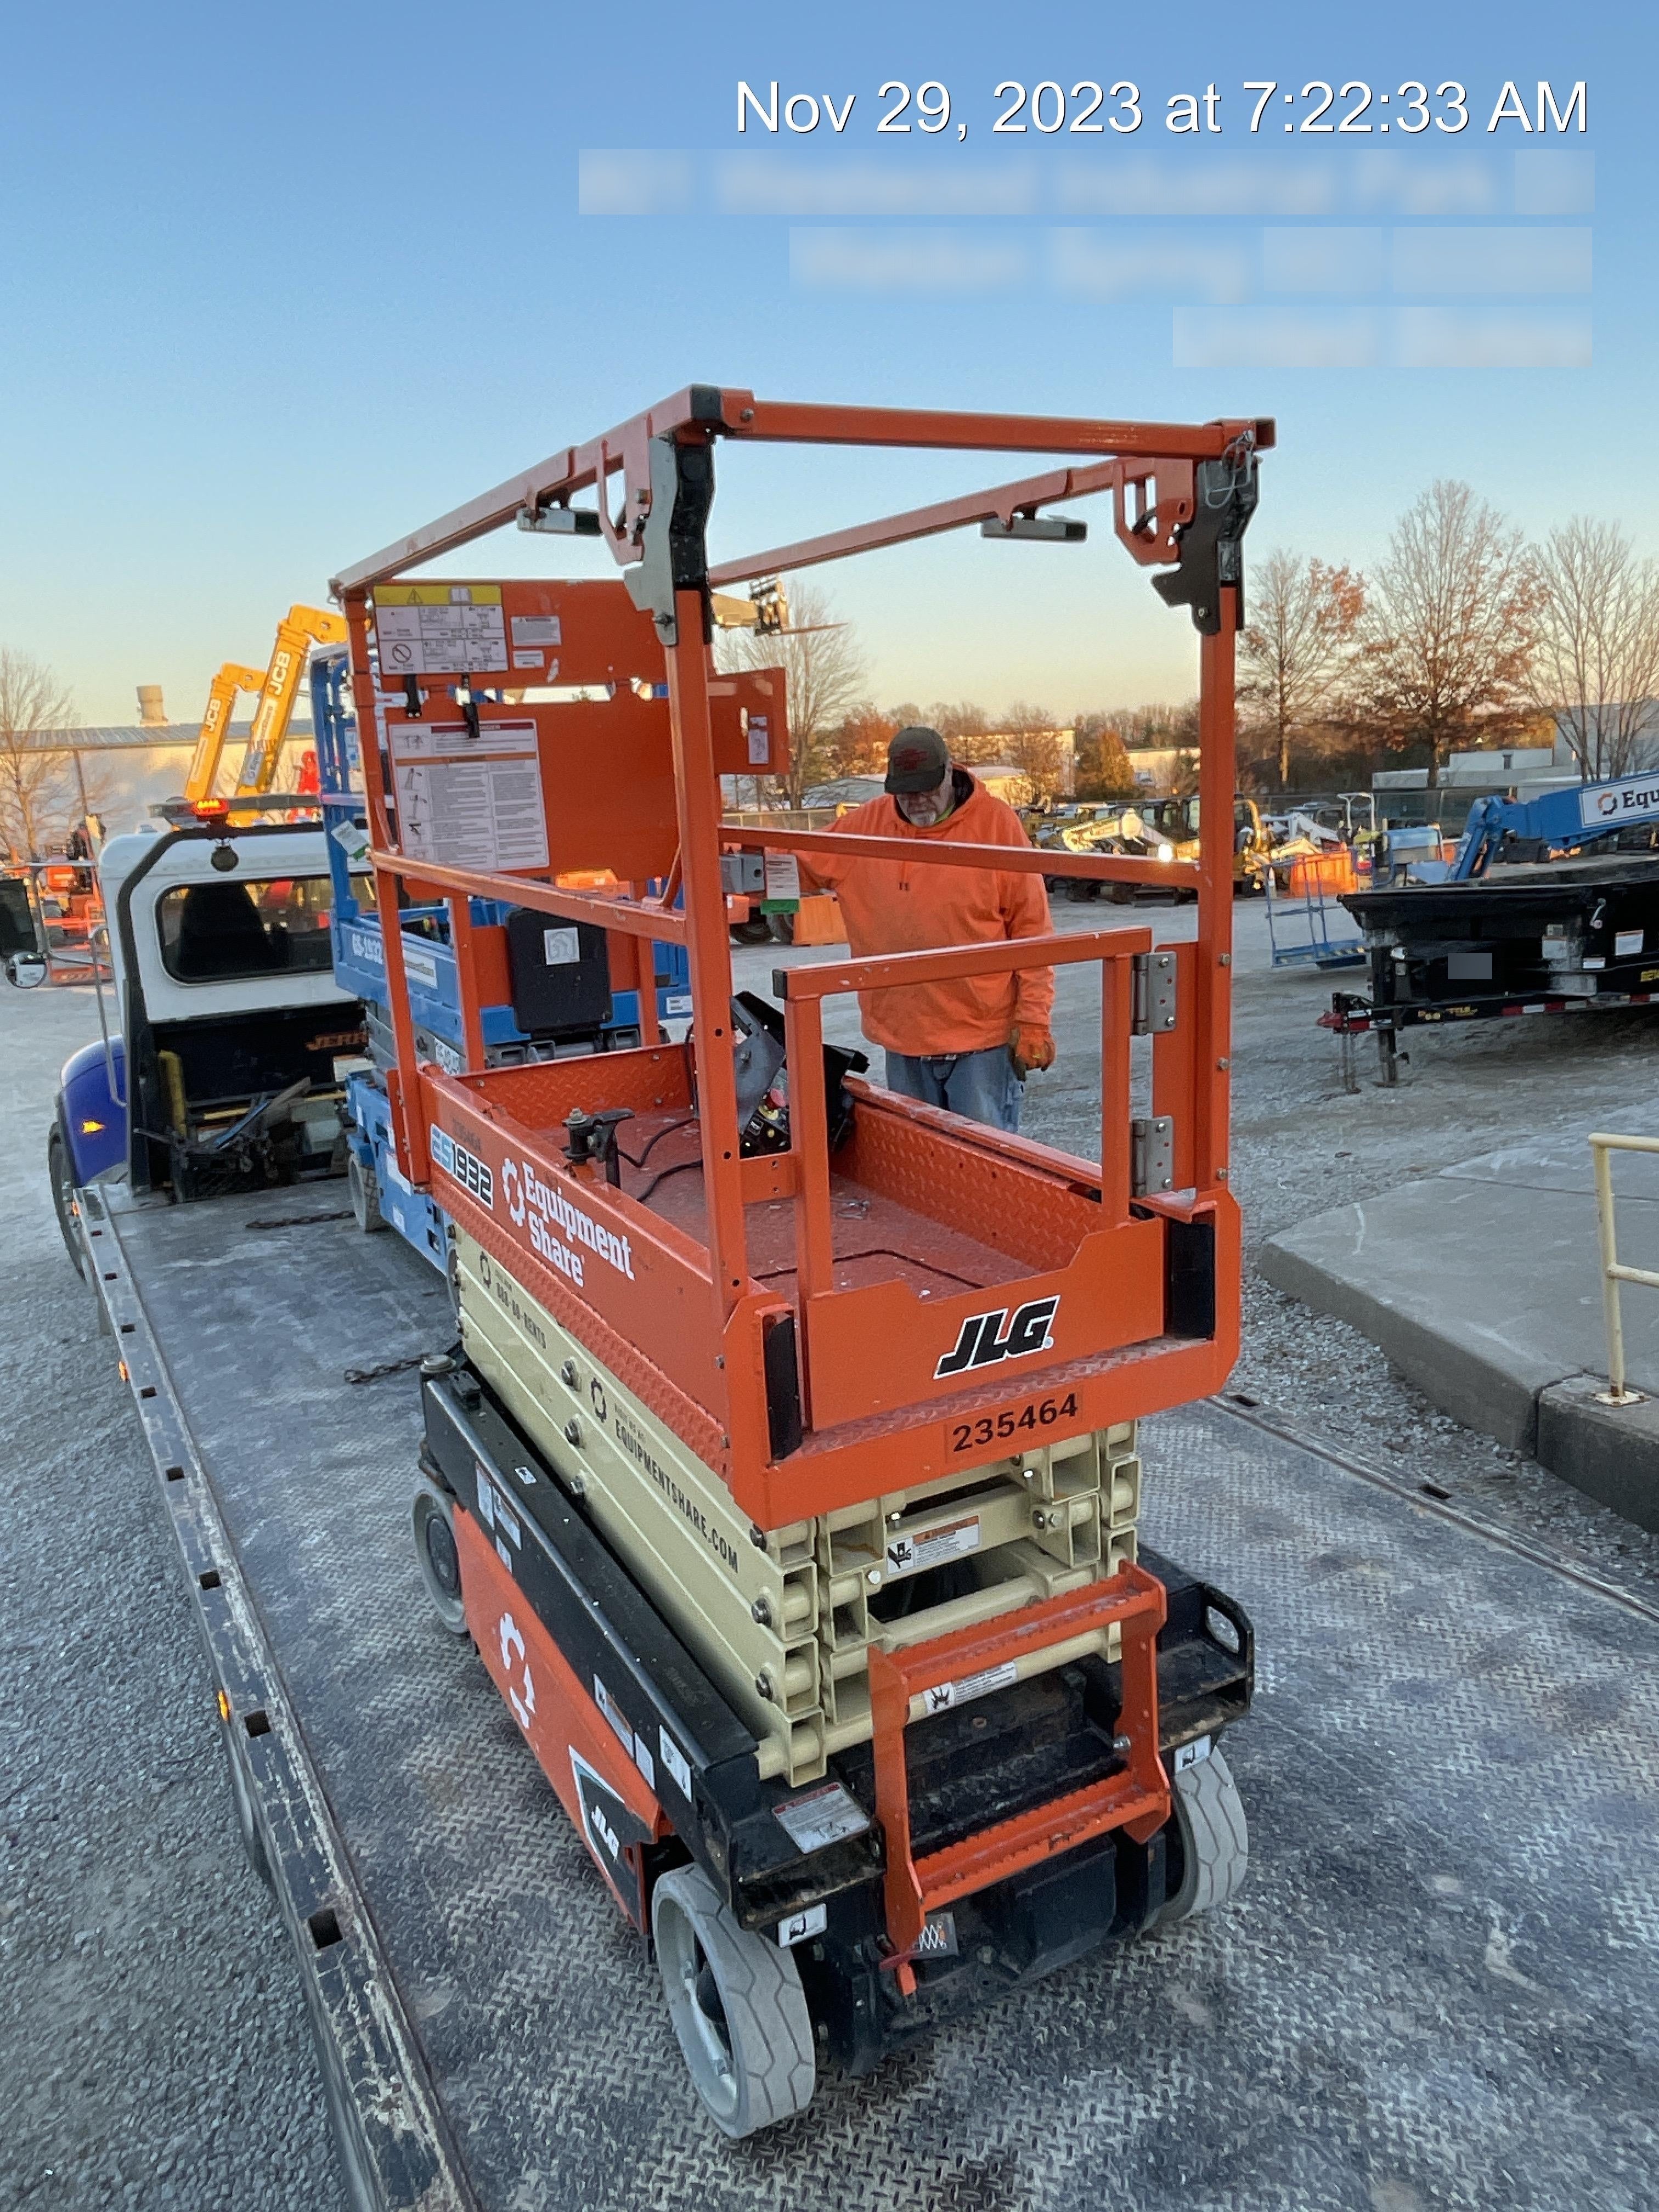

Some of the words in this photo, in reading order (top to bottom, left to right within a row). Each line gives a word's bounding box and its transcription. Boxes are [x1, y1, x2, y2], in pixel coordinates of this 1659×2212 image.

[270, 651, 291, 696] JCB
[205, 699, 222, 732] JCB
[522, 1161, 635, 1281] Equipment
[528, 1210, 584, 1287] Share
[934, 1295, 1060, 1379] JLG
[952, 1393, 1077, 1453] 235464
[616, 1419, 738, 1573] EQUIPMENTSHARE.COM
